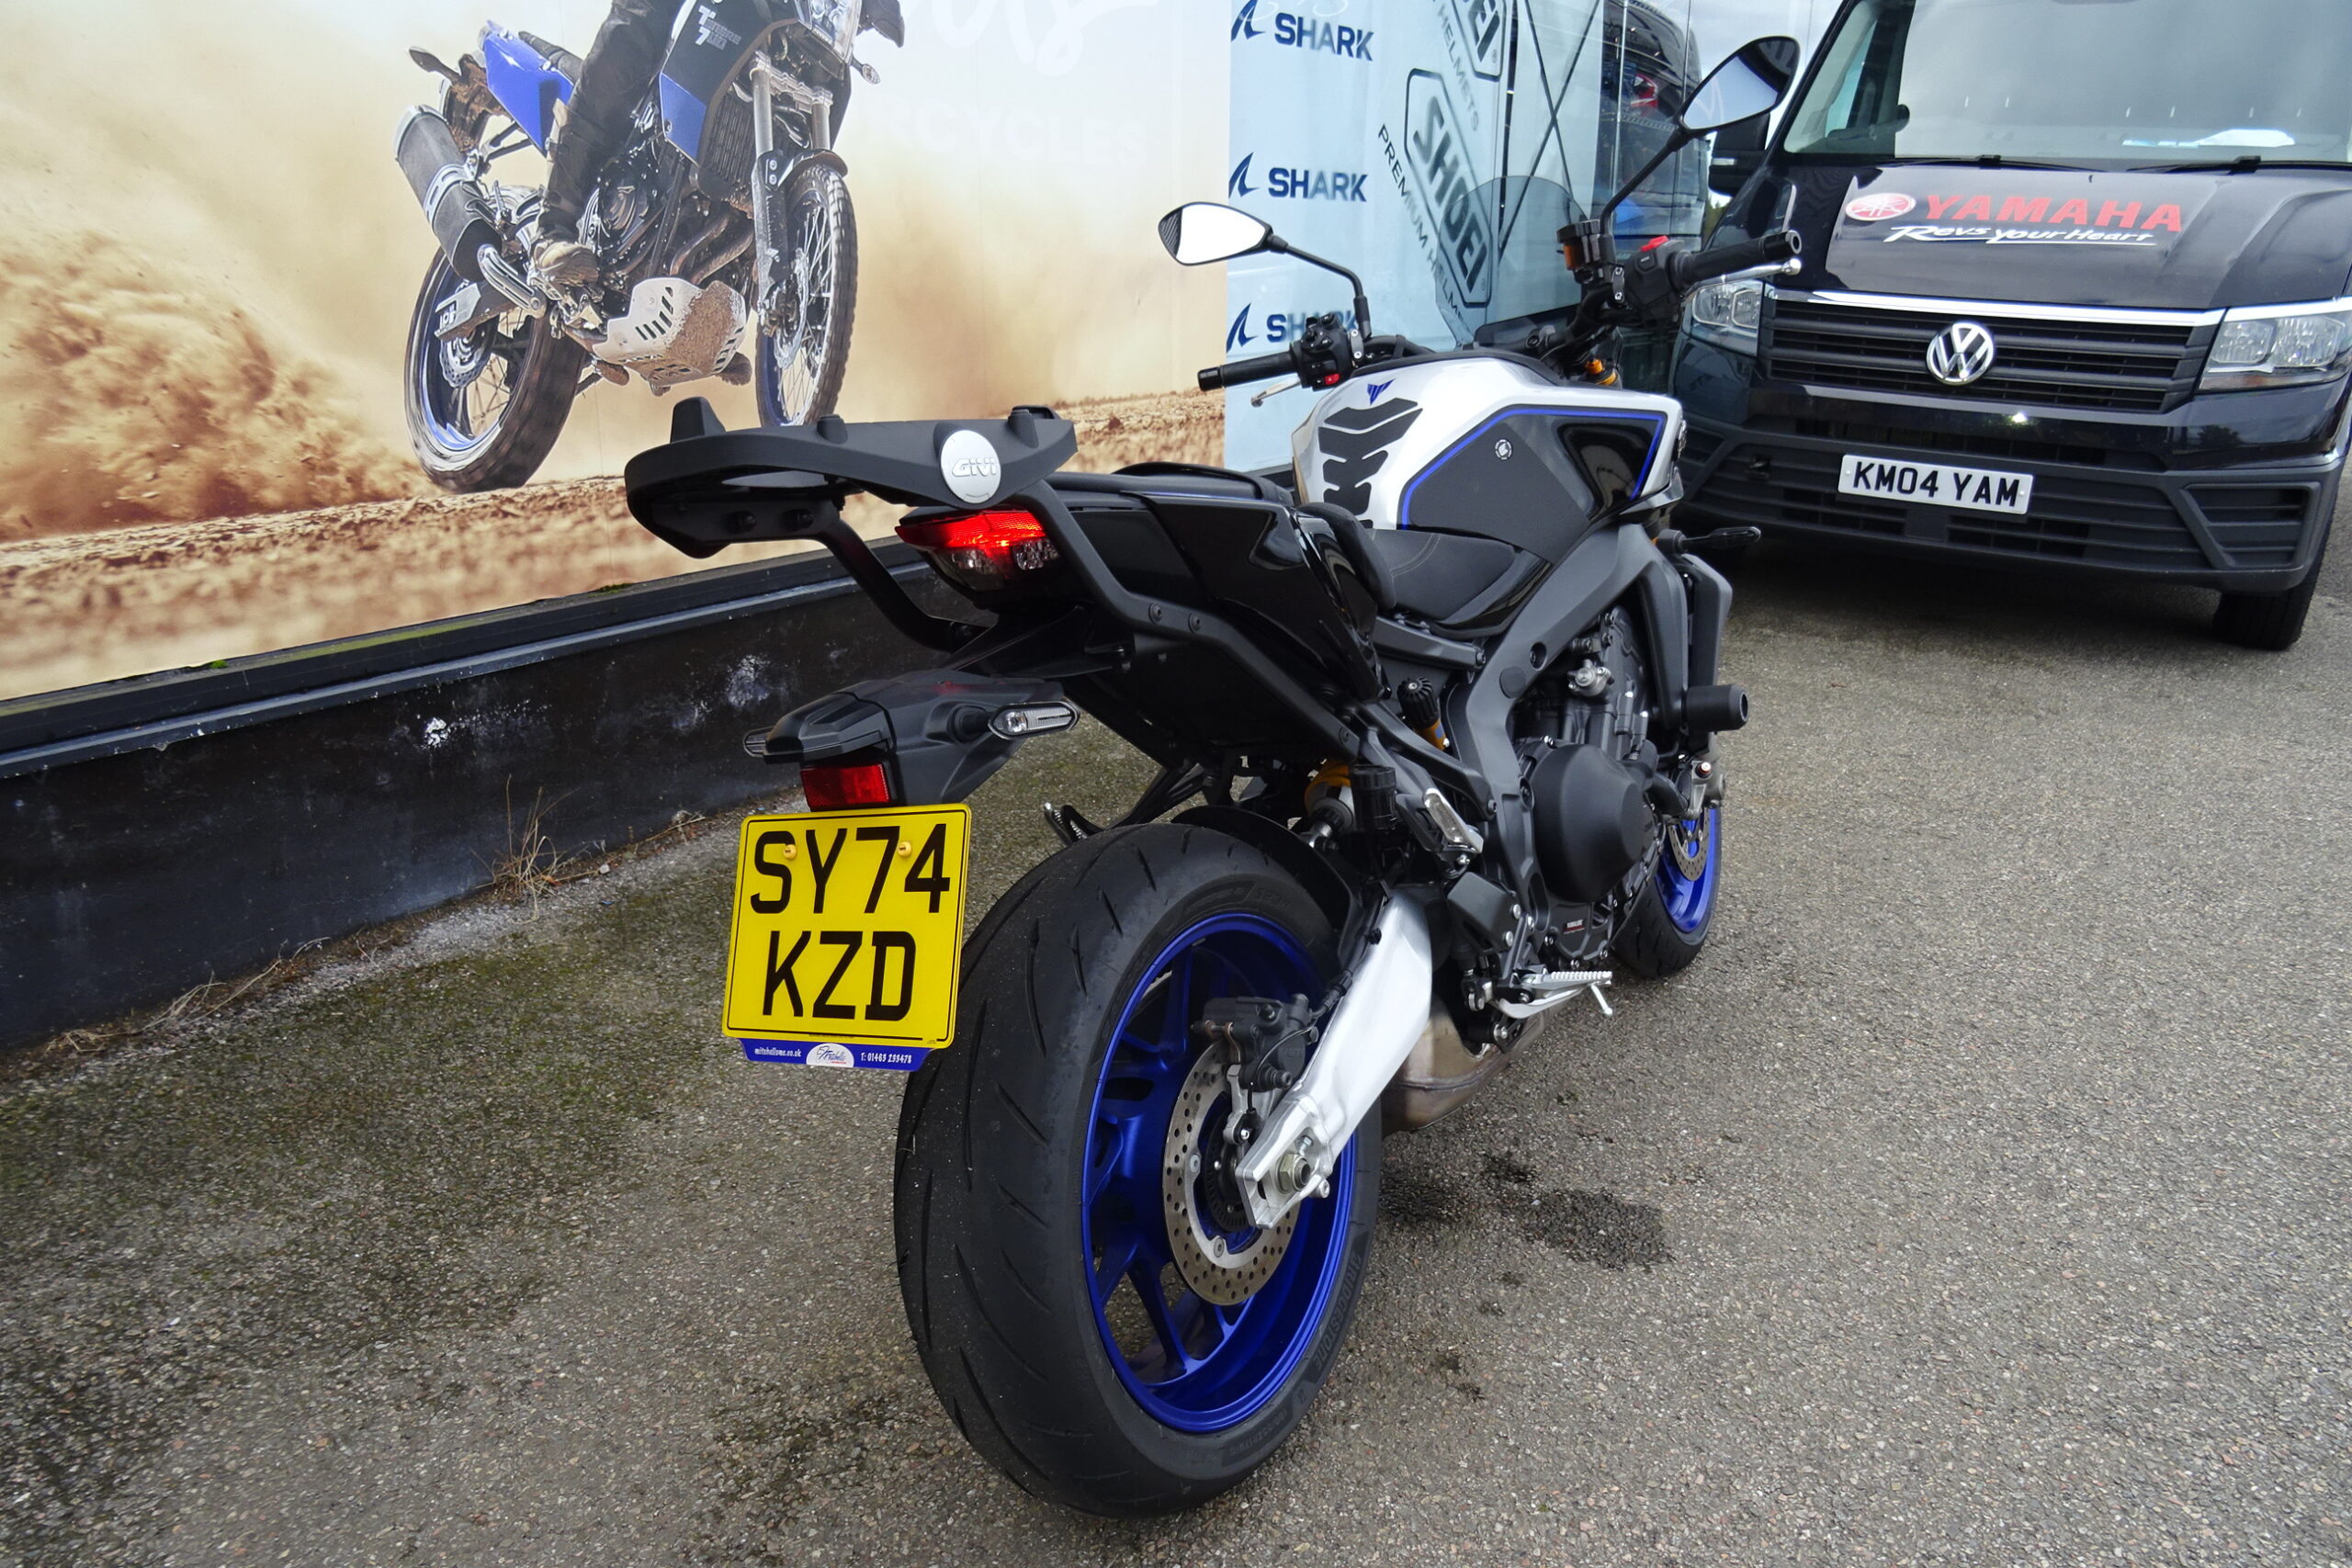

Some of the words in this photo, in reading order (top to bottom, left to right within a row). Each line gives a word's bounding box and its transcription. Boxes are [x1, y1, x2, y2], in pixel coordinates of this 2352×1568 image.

[1274, 13, 1374, 61] SHARK
[1268, 167, 1367, 202] SHARK
[1378, 123, 1428, 249] PREMIUM
[1413, 96, 1487, 294] SHOEI
[1883, 225, 1990, 243] Revs
[2064, 229, 2155, 243] Heart
[1926, 195, 2182, 232] YAMAHA
[1853, 462, 1939, 498] KM04
[1953, 472, 2020, 508] YAM
[750, 823, 951, 914] SY74
[762, 931, 916, 1021] KZD
